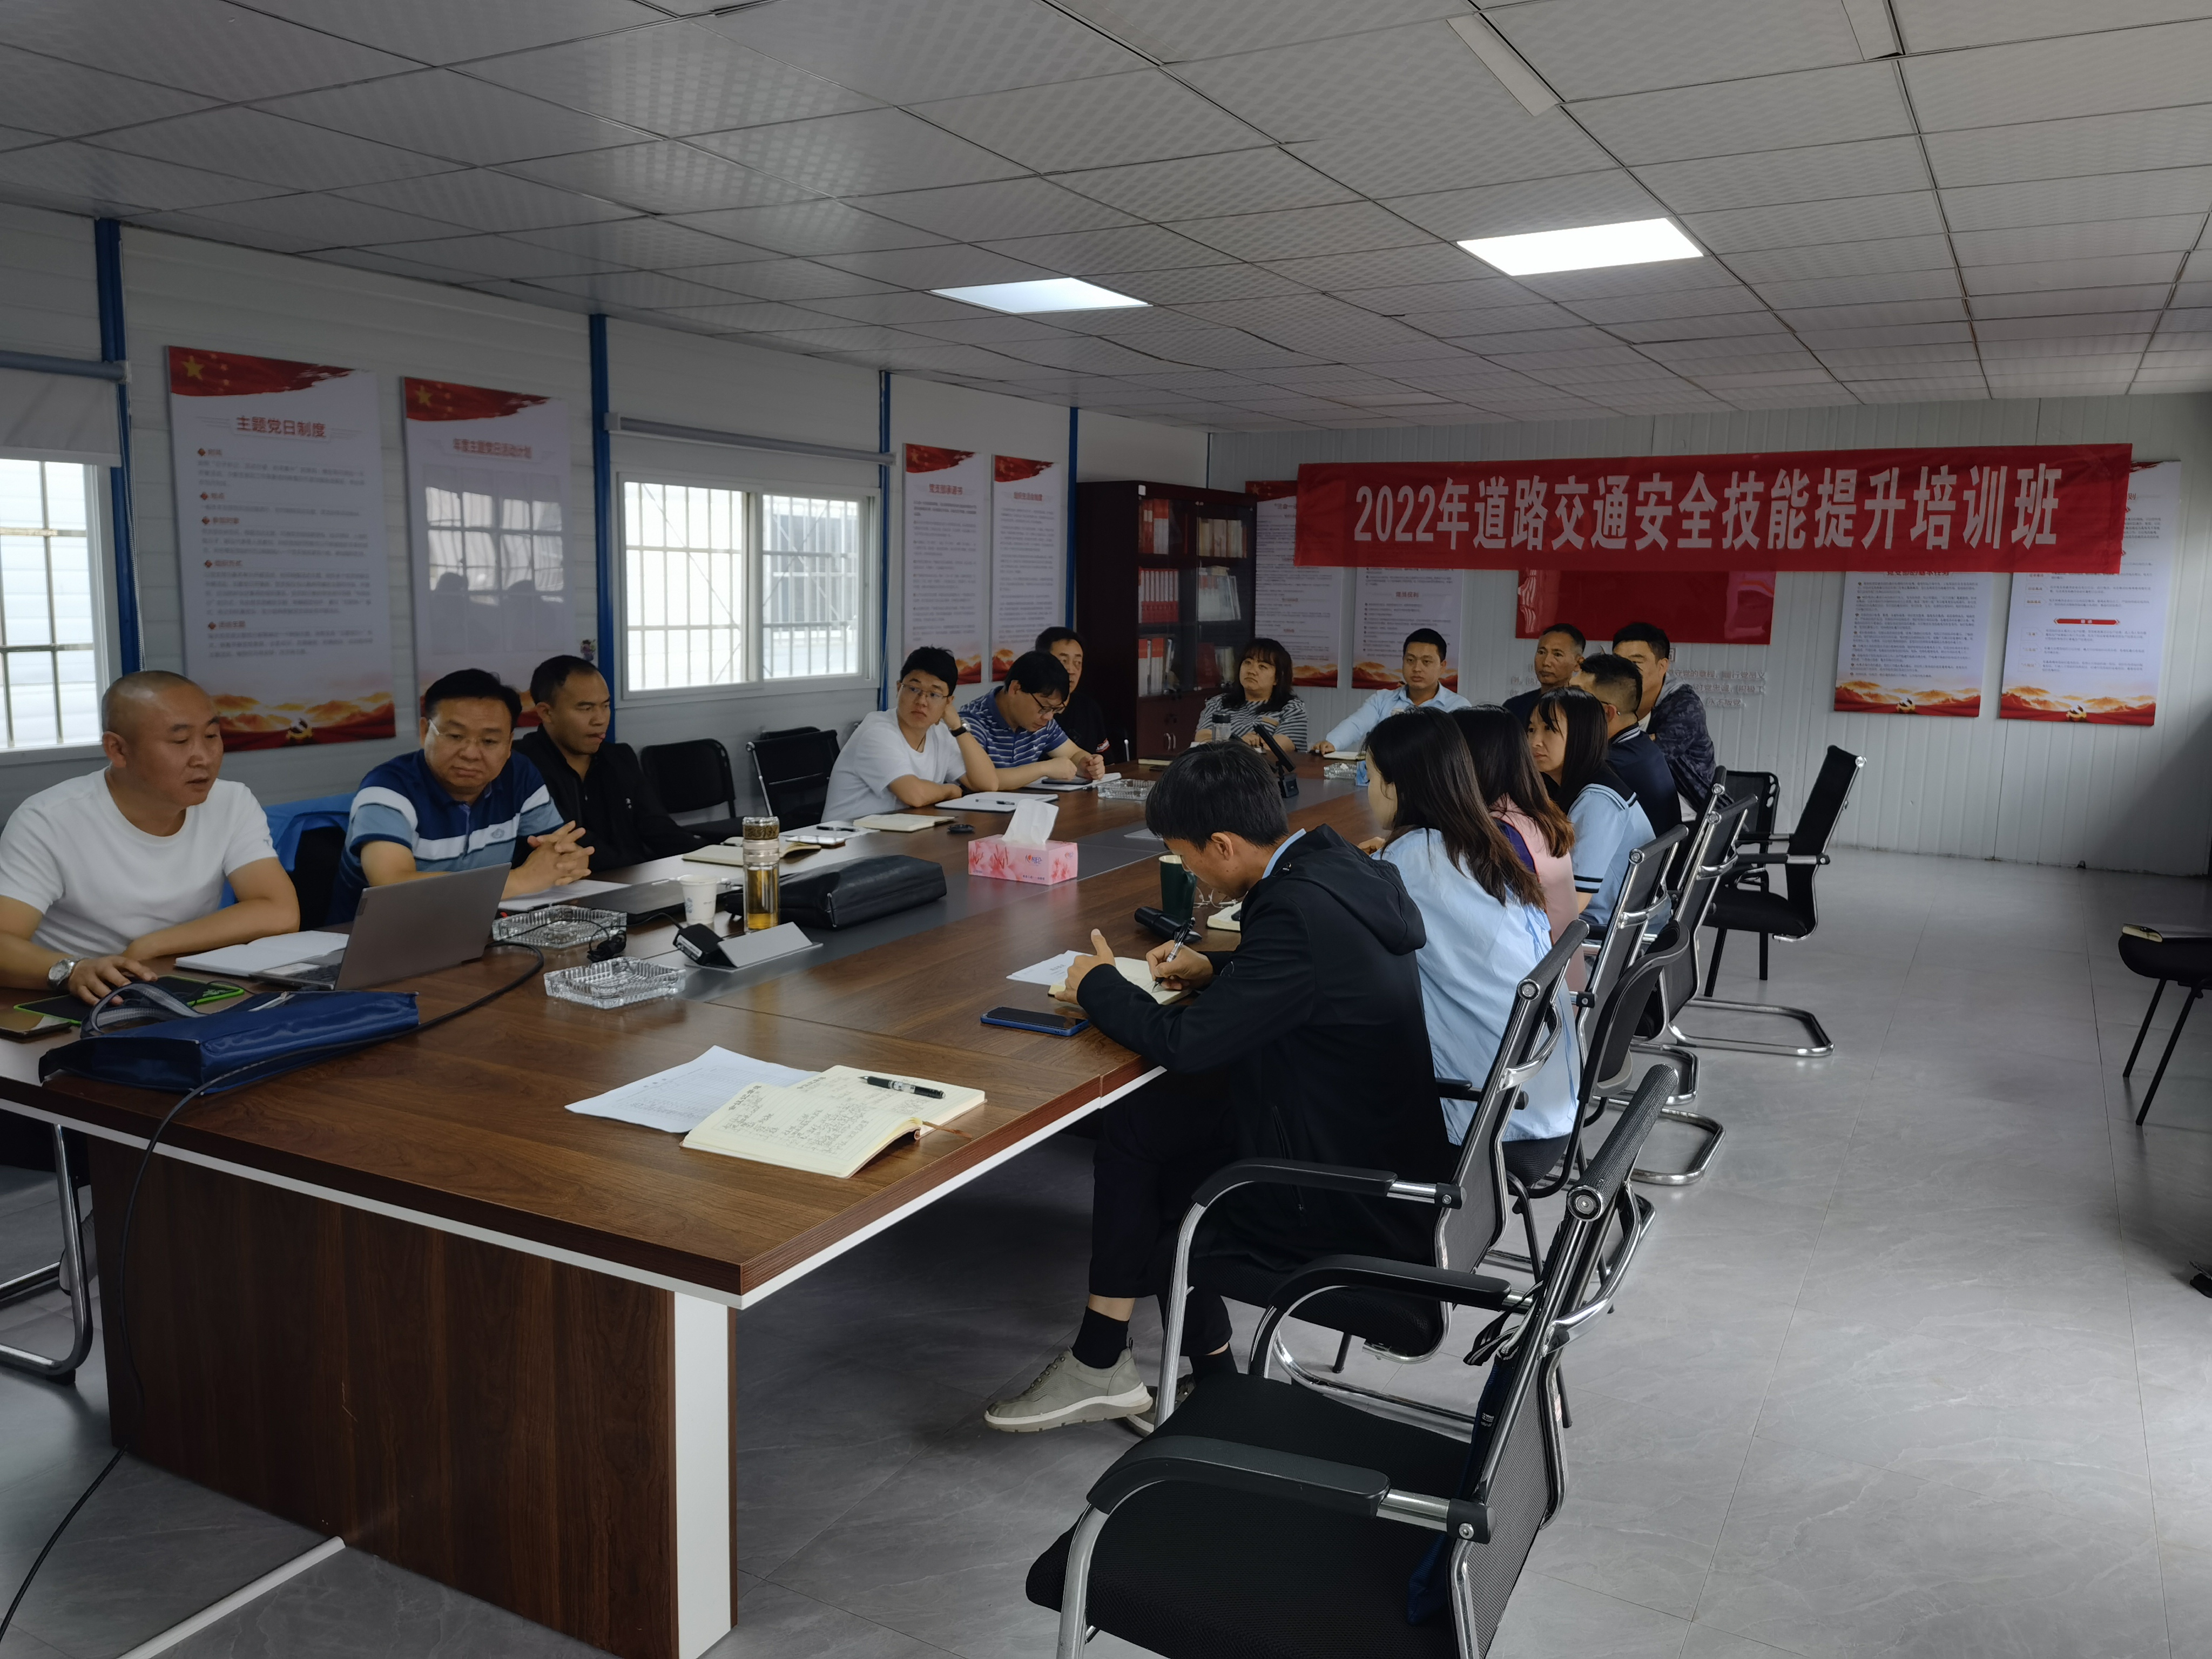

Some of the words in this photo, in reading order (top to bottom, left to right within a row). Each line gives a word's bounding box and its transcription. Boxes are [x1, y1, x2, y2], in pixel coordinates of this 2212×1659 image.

[236, 415, 327, 438] 主题党日制度
[1354, 462, 2060, 551] 2022年道路交通安全技能提升培训班
